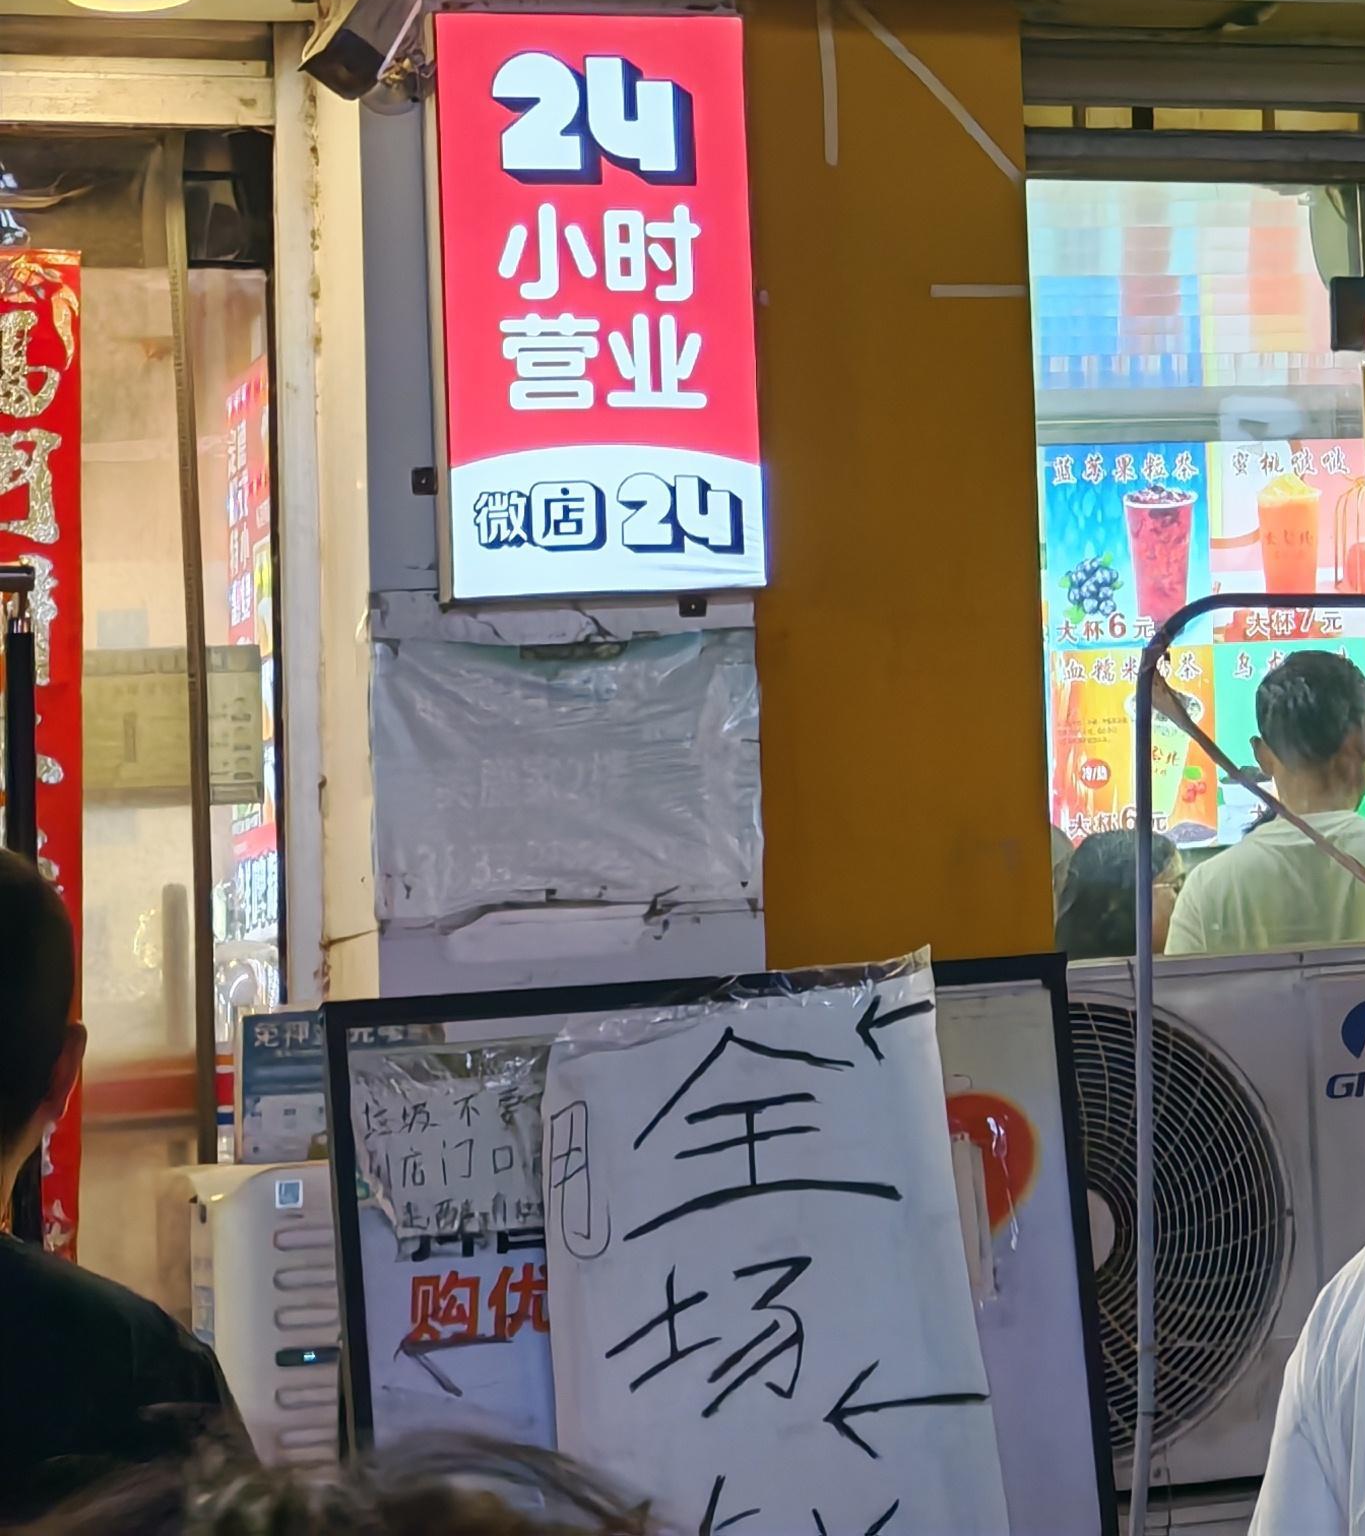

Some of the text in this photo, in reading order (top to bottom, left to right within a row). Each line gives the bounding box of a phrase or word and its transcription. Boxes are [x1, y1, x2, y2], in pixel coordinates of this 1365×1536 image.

[490, 52, 696, 185] 24
[498, 203, 701, 302] 小时
[499, 315, 707, 411] 营业
[1053, 451, 1199, 485] 蓝莓果粒茶
[474, 474, 743, 554] 微店 24
[1057, 612, 1155, 642] 大杯6元
[1246, 608, 1342, 636] 大杯7元
[607, 1024, 902, 1536] 全场
